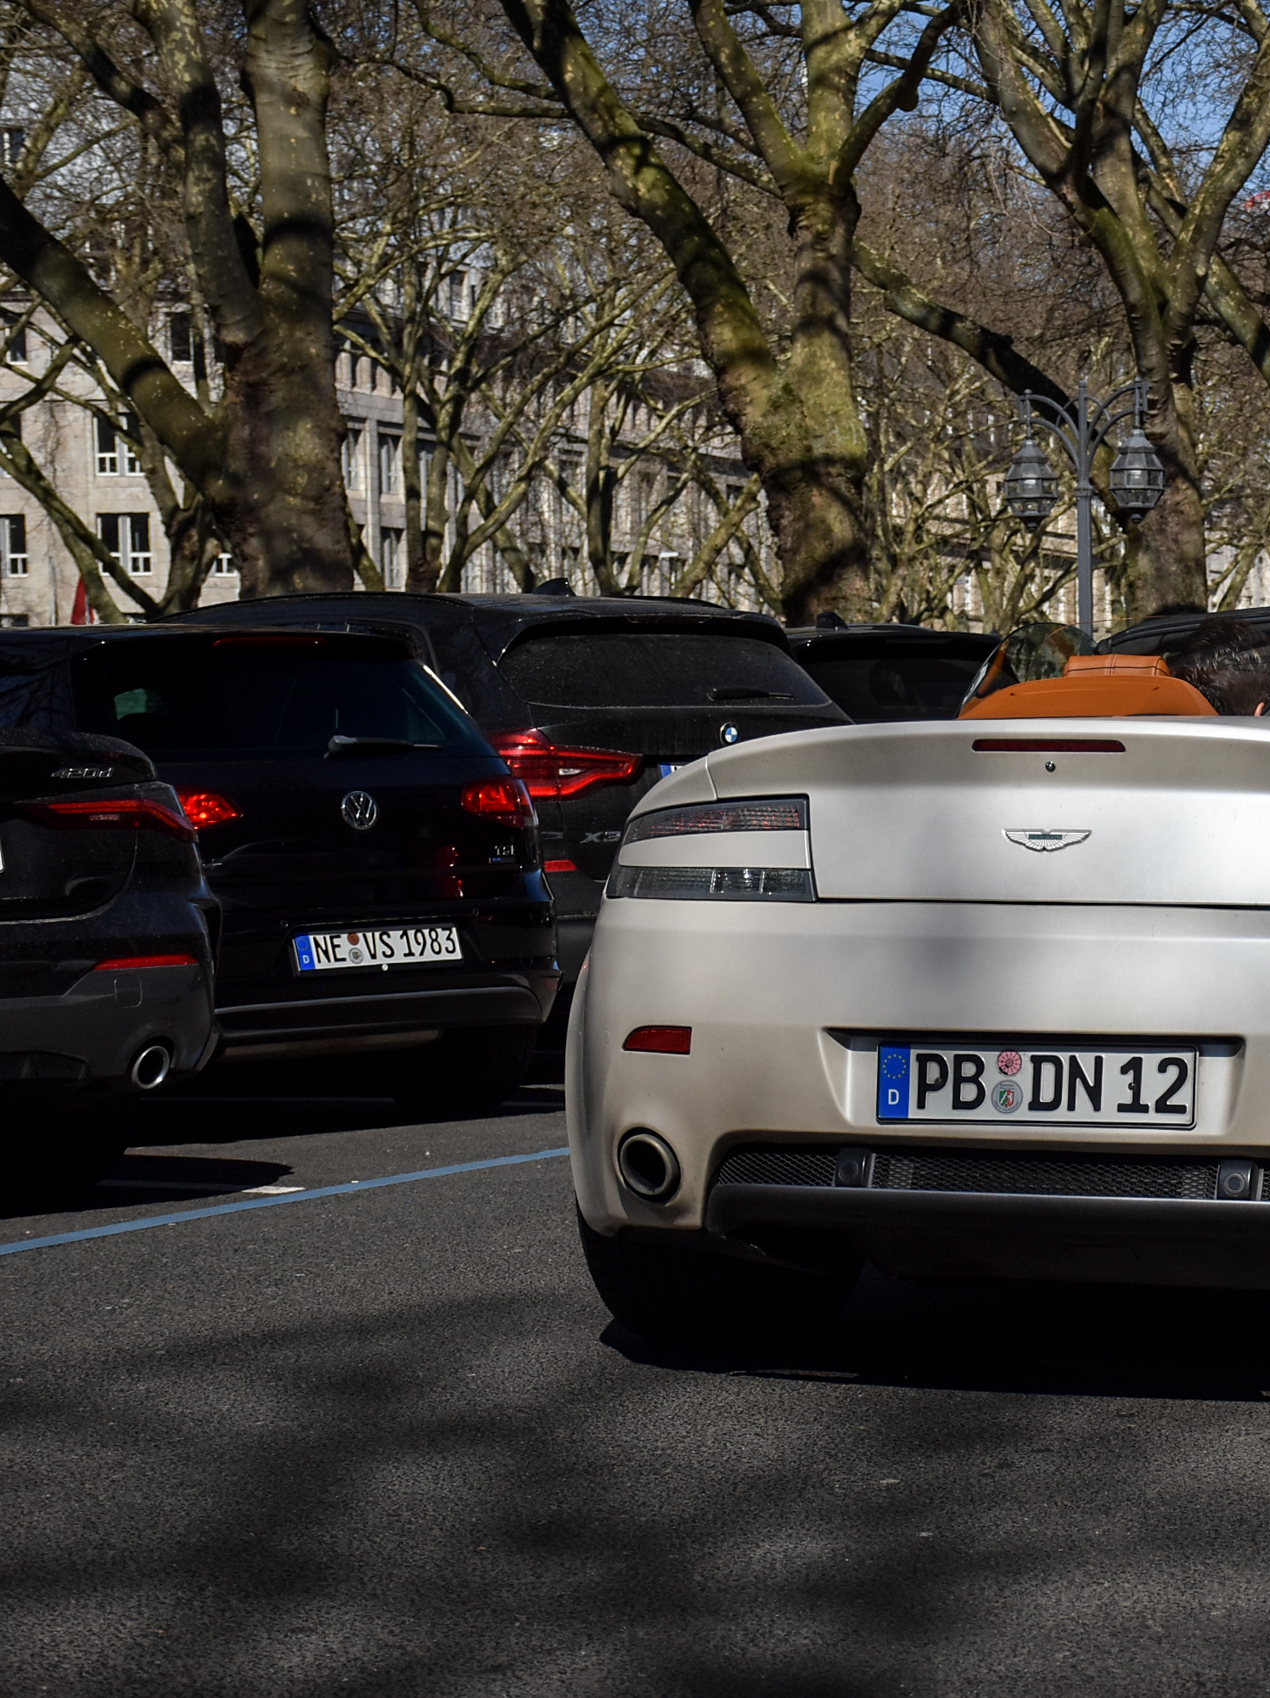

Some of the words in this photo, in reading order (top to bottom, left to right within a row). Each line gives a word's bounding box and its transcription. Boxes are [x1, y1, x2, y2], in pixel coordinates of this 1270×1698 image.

[51, 767, 114, 779] 420d
[580, 831, 622, 845] X3
[312, 934, 347, 965] NE
[362, 930, 396, 960] VS
[399, 926, 457, 958] 1983
[887, 1089, 900, 1105] D
[915, 1053, 988, 1111] PB
[1027, 1054, 1104, 1113] DN
[1116, 1055, 1189, 1115] 12
